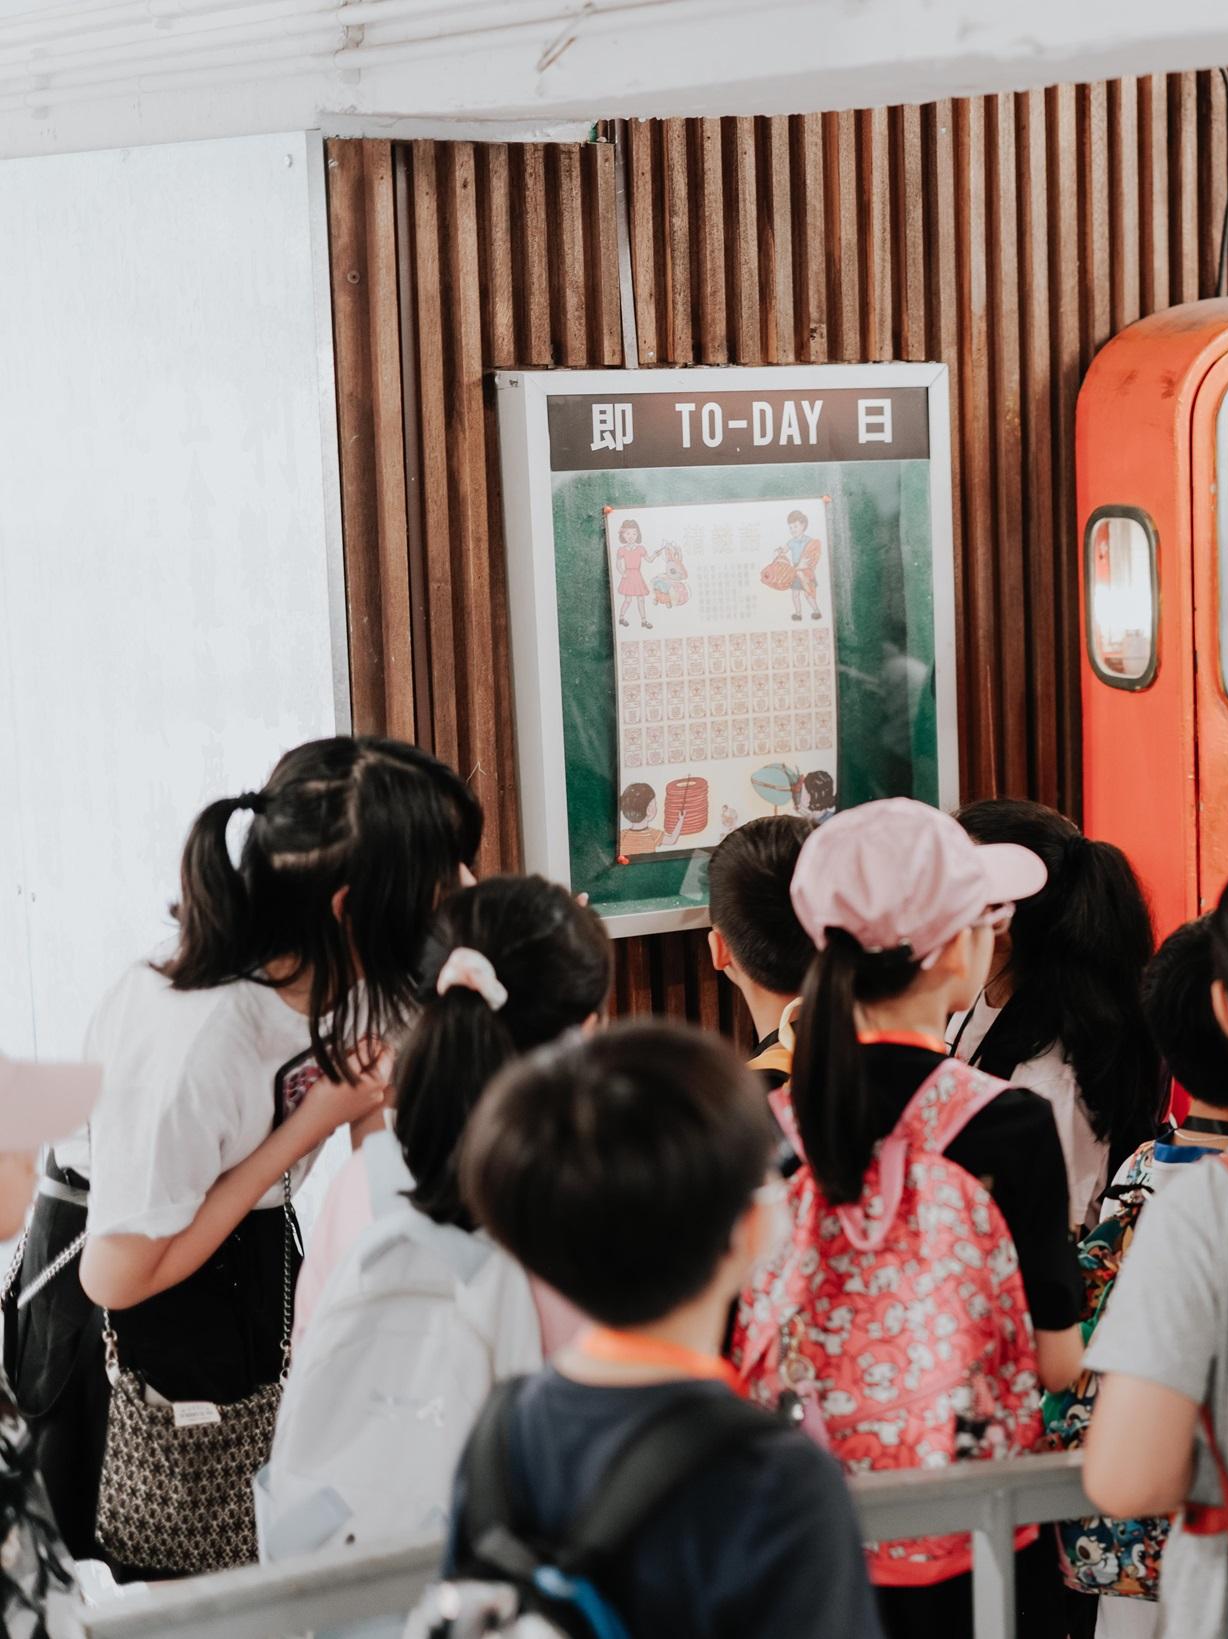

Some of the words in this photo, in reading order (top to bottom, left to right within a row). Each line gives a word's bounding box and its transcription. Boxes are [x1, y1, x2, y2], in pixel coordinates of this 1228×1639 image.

[590, 402, 634, 452] 即
[675, 400, 823, 448] TO-DAY
[857, 398, 893, 444] 日
